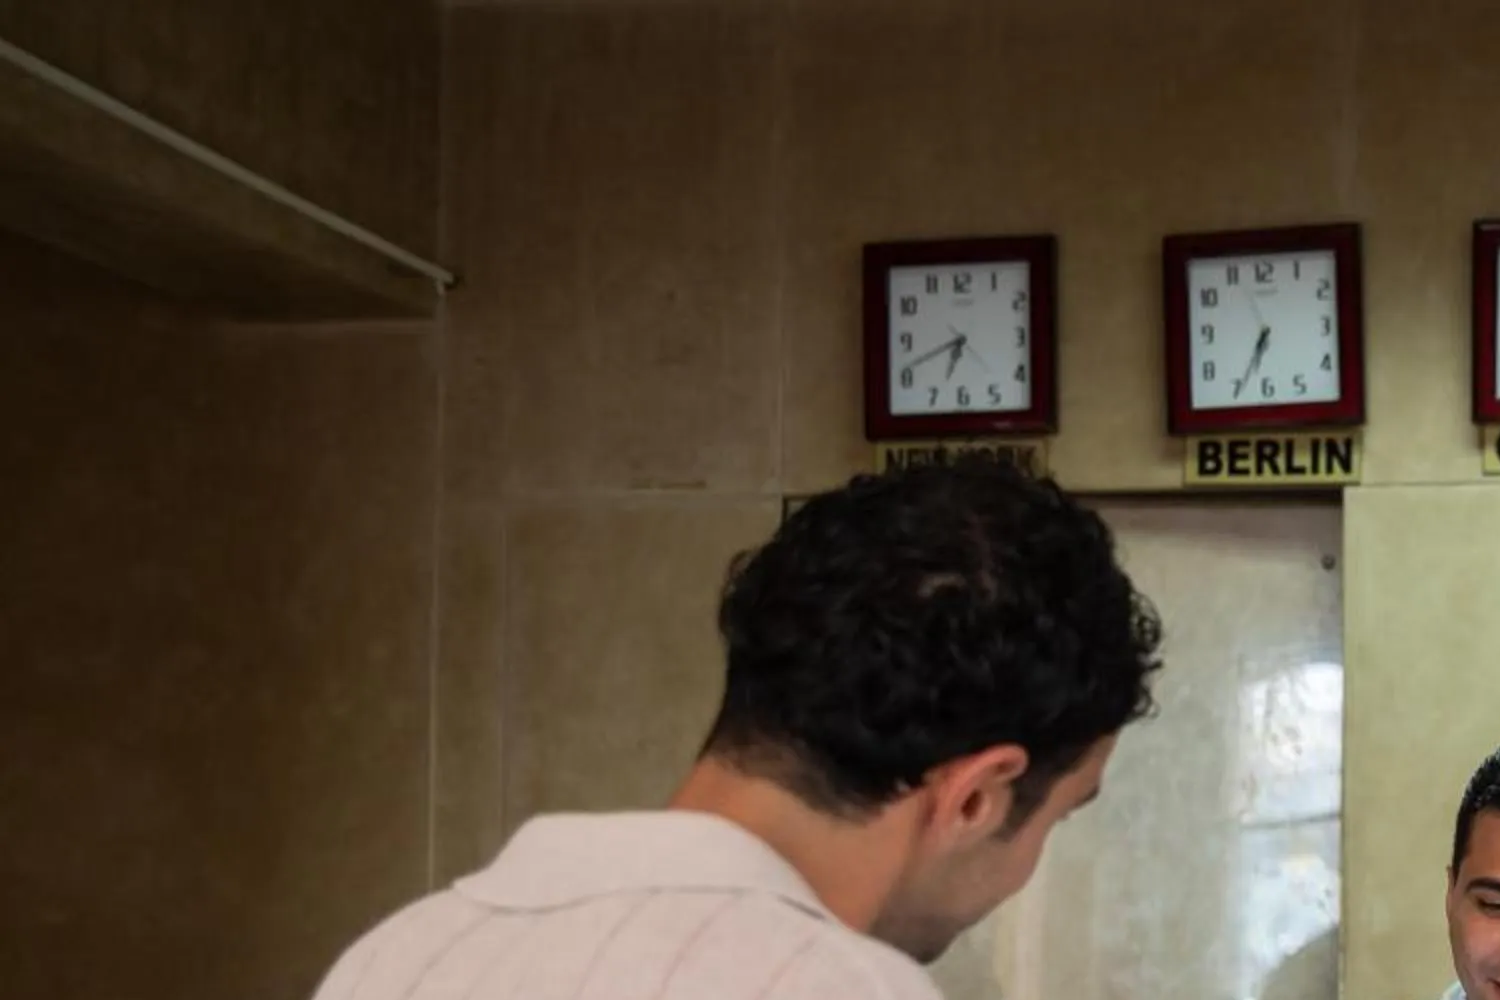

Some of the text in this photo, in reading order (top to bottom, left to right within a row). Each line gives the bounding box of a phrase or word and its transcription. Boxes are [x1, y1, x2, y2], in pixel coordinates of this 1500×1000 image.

[1226, 265, 1239, 285] 11
[1254, 262, 1274, 283] 12
[1294, 260, 1300, 281] 1
[926, 274, 938, 294] 11
[953, 273, 972, 293] 12
[991, 272, 997, 292] 1
[1317, 279, 1330, 300] 2
[901, 296, 917, 315] 10
[1013, 291, 1027, 312] 2
[1201, 288, 1217, 308] 10
[1016, 326, 1026, 347] 3
[1201, 325, 1214, 344] 9
[1321, 316, 1330, 337] 3
[901, 333, 912, 351] 9
[1203, 361, 1215, 381] 8
[1320, 353, 1331, 371] 4
[988, 384, 1001, 405] 5
[1231, 379, 1242, 399] 7
[1261, 377, 1275, 398] 6
[1293, 375, 1307, 395] 5
[929, 387, 938, 406] 7
[956, 386, 970, 406] 6
[1198, 438, 1353, 477] BERLIN
